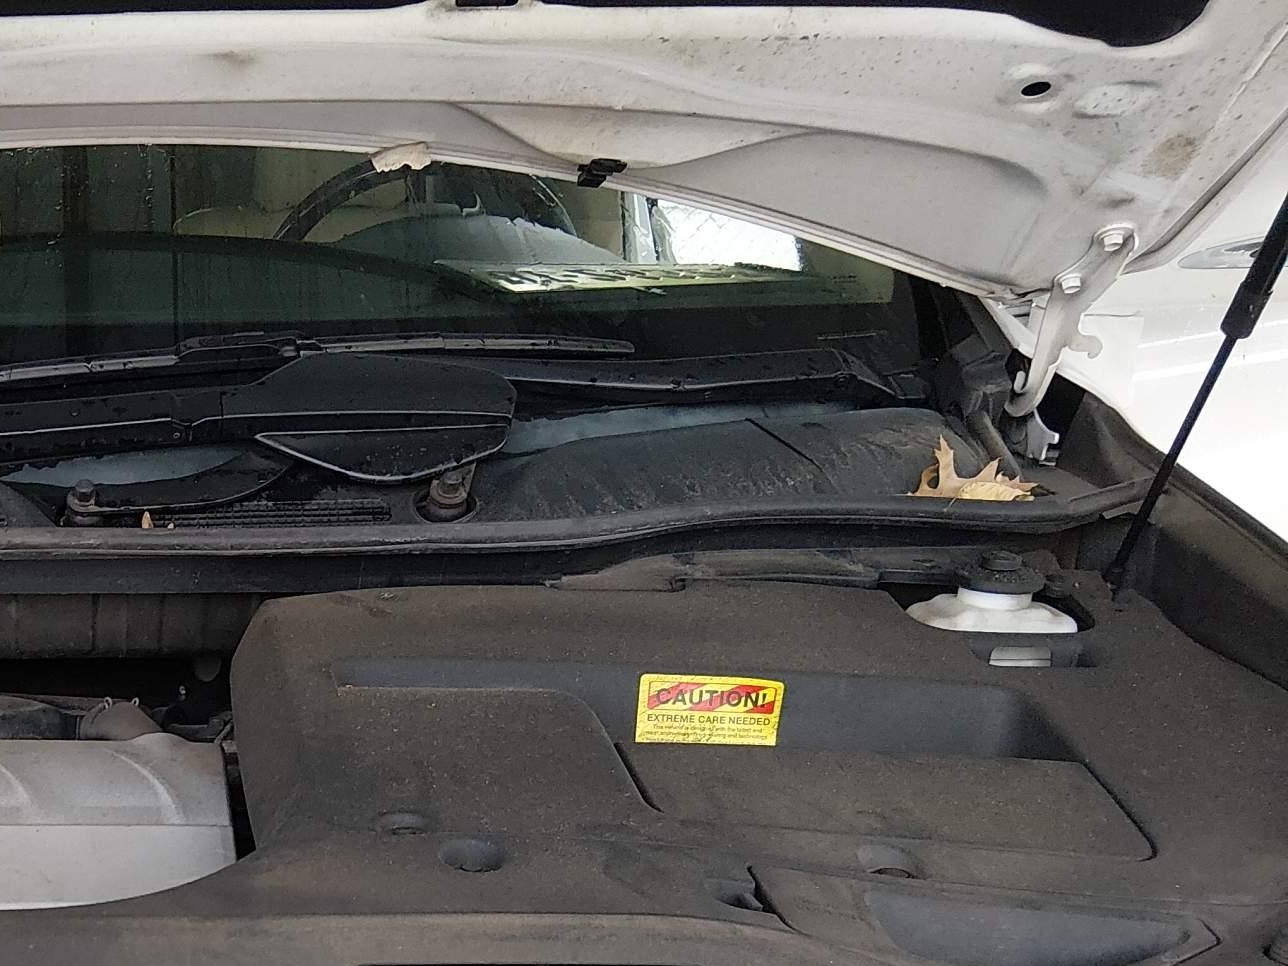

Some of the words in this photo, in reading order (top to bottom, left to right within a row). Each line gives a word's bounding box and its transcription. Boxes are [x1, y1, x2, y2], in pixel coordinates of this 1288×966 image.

[656, 687, 768, 708] CAUTION!
[647, 713, 695, 724] EXTREME
[698, 715, 726, 725] CARE
[728, 716, 771, 726] NEEDED
